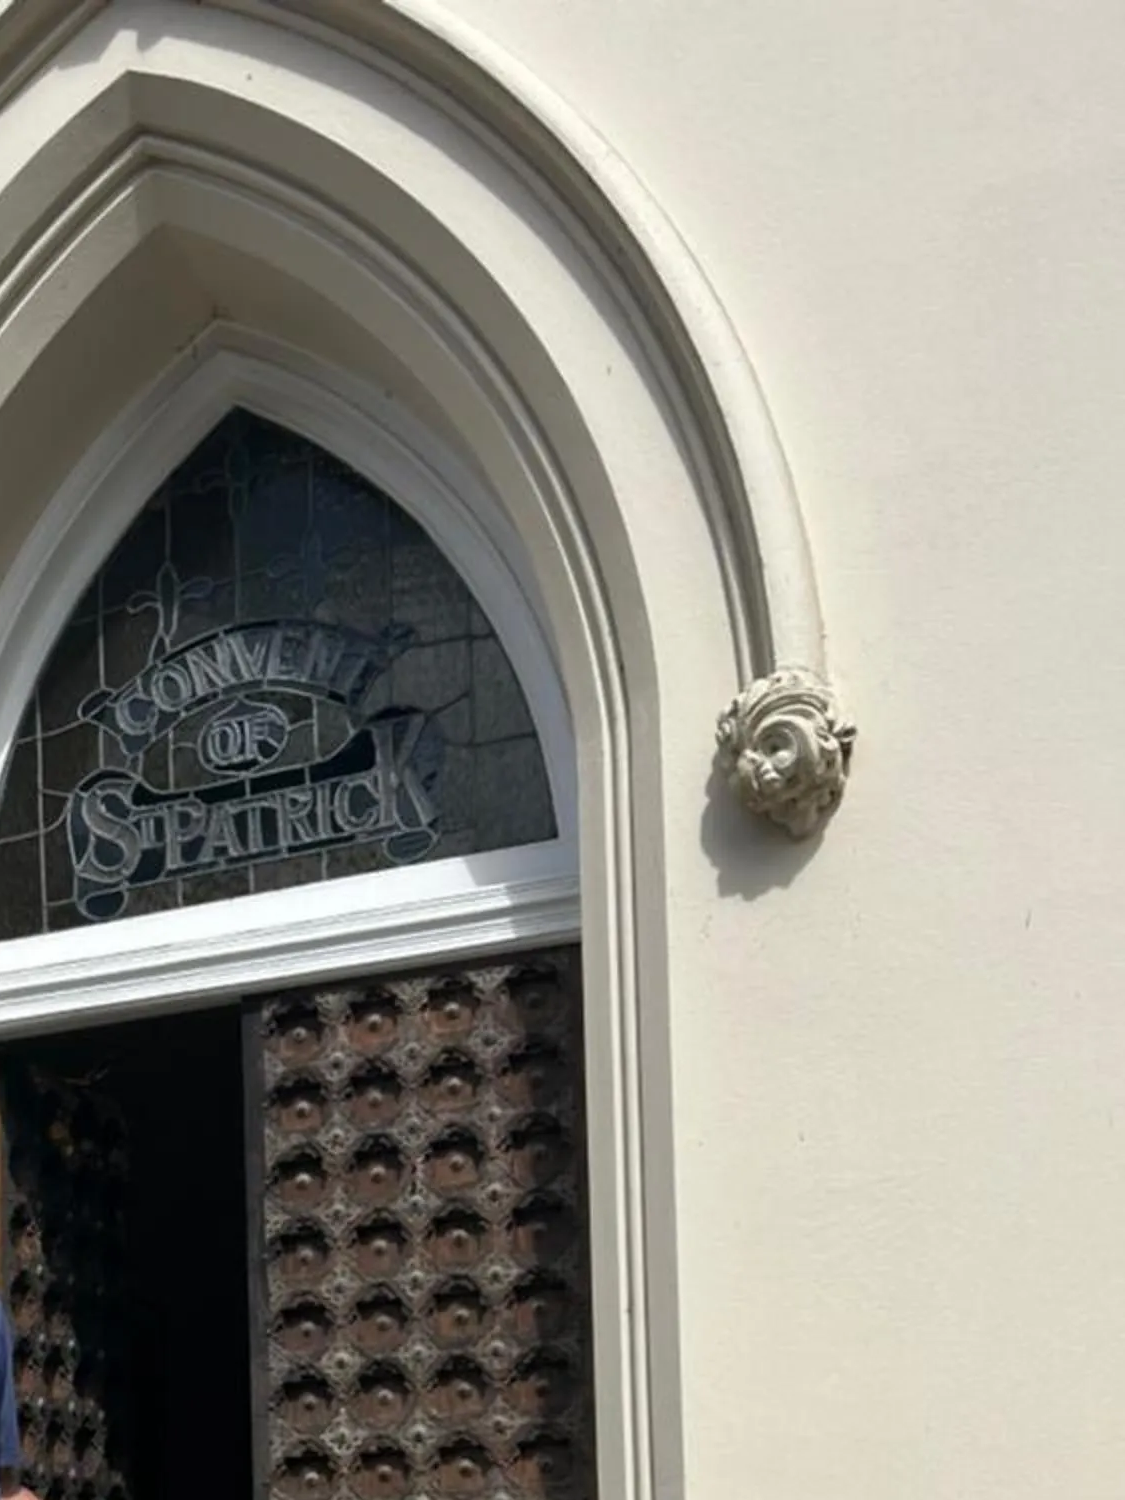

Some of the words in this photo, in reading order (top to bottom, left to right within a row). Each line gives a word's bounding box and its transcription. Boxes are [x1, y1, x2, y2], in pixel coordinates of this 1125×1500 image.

[115, 628, 377, 736] CONVENT
[207, 712, 277, 766] OF
[163, 718, 438, 870] PATRICK
